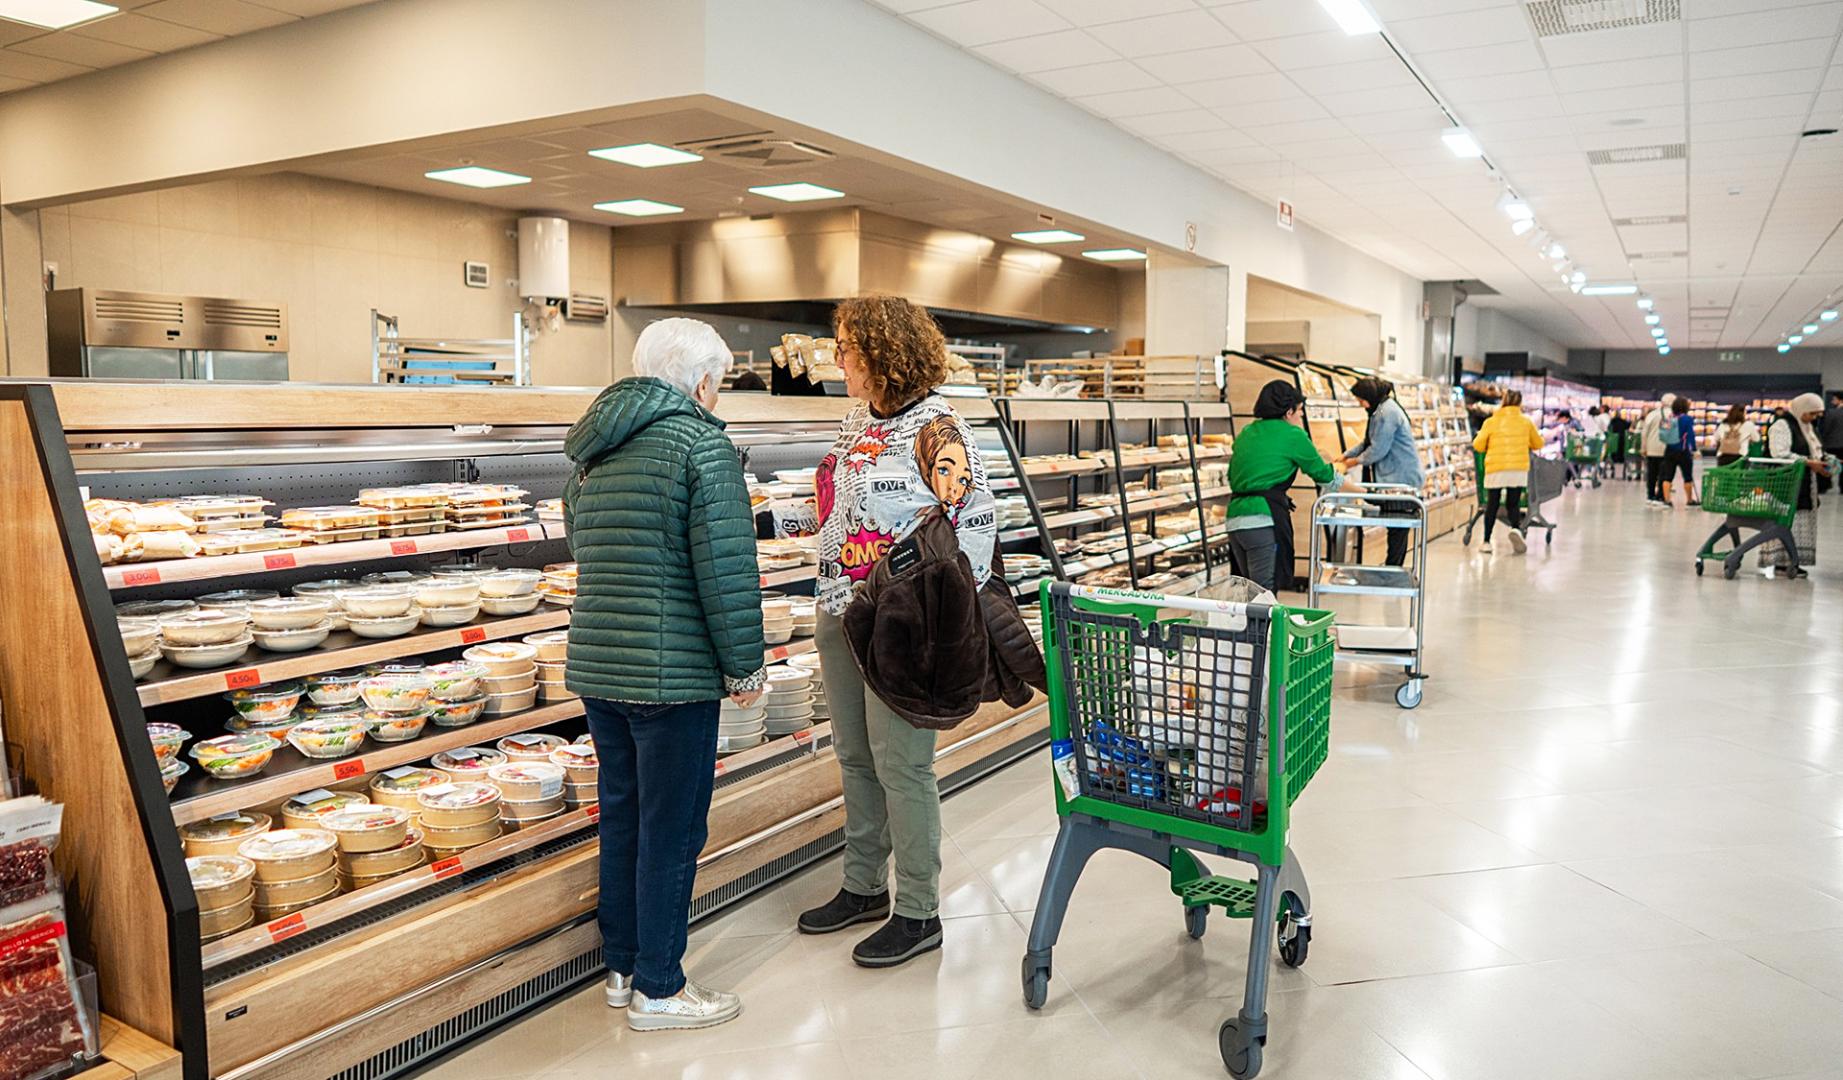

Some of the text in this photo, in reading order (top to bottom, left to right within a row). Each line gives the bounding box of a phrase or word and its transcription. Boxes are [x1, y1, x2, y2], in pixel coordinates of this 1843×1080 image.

[871, 480, 907, 493] LOVE
[964, 511, 994, 528] LOVE
[841, 539, 891, 567] OMG
[1097, 587, 1165, 601] MERCADONA
